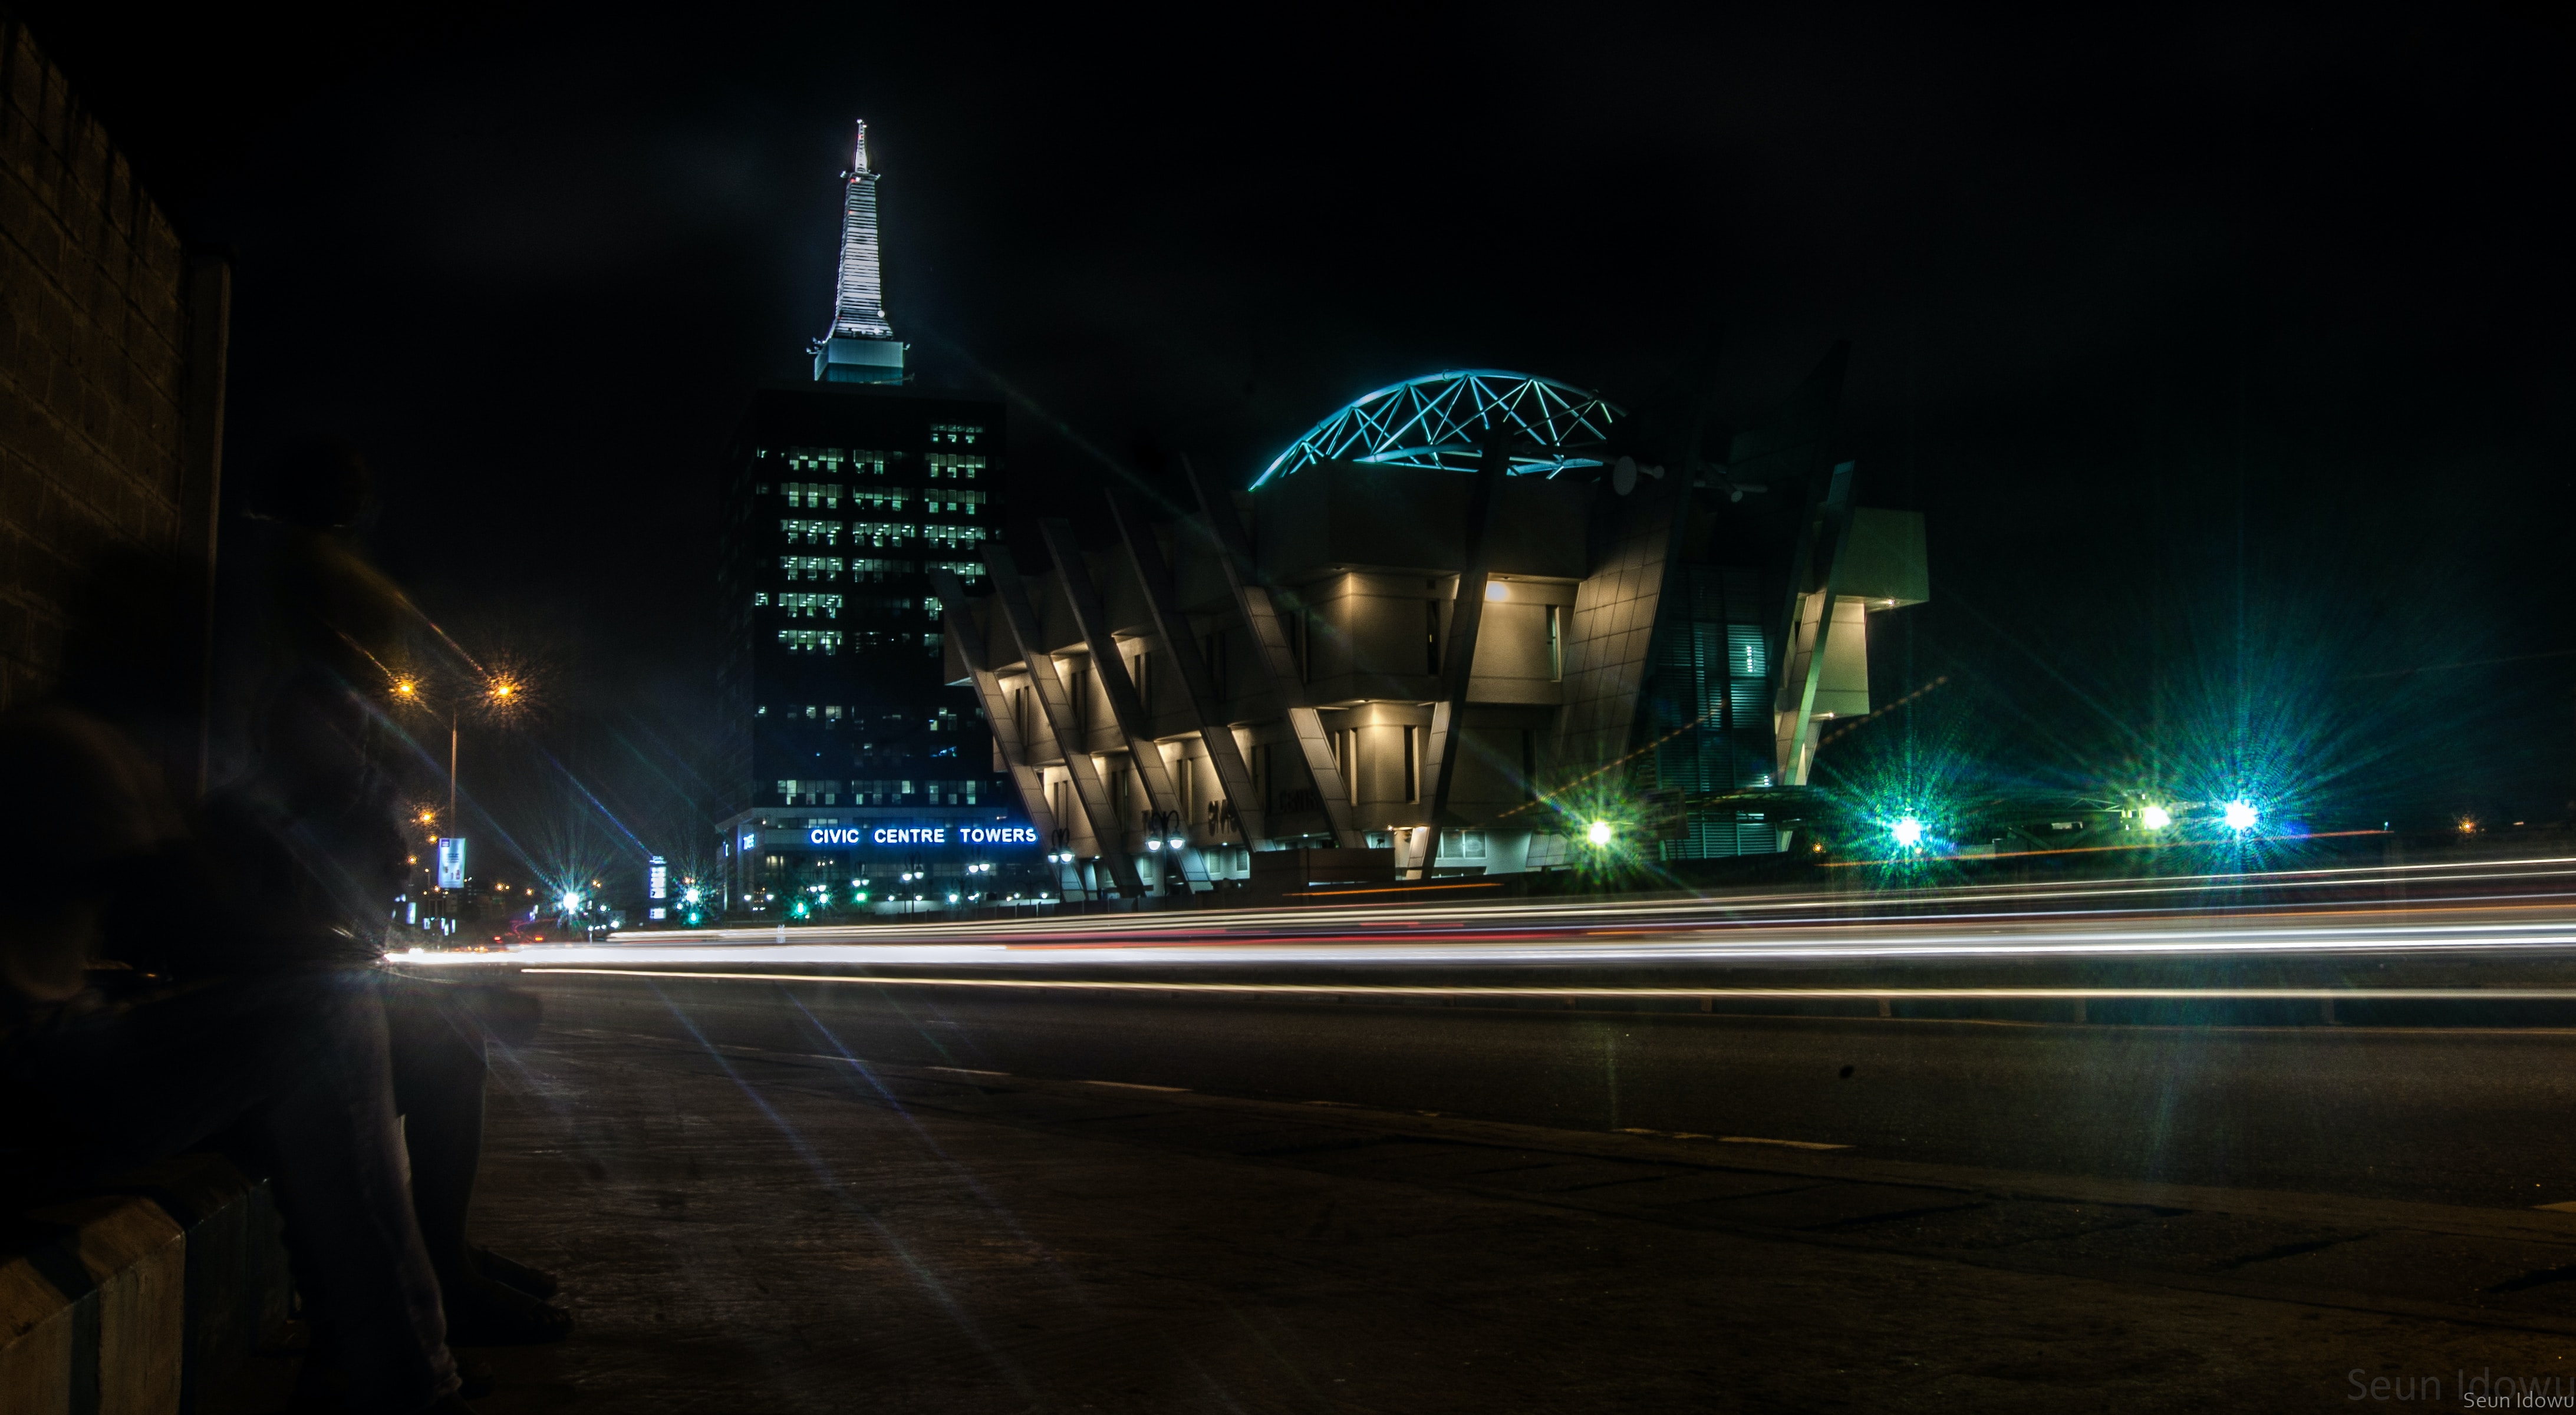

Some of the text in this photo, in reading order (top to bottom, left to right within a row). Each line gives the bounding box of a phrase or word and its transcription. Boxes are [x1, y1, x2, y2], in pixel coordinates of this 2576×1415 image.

[1279, 789, 1320, 812] CENTR
[811, 827, 1037, 843] CIVIC CENTRE TOWERS
